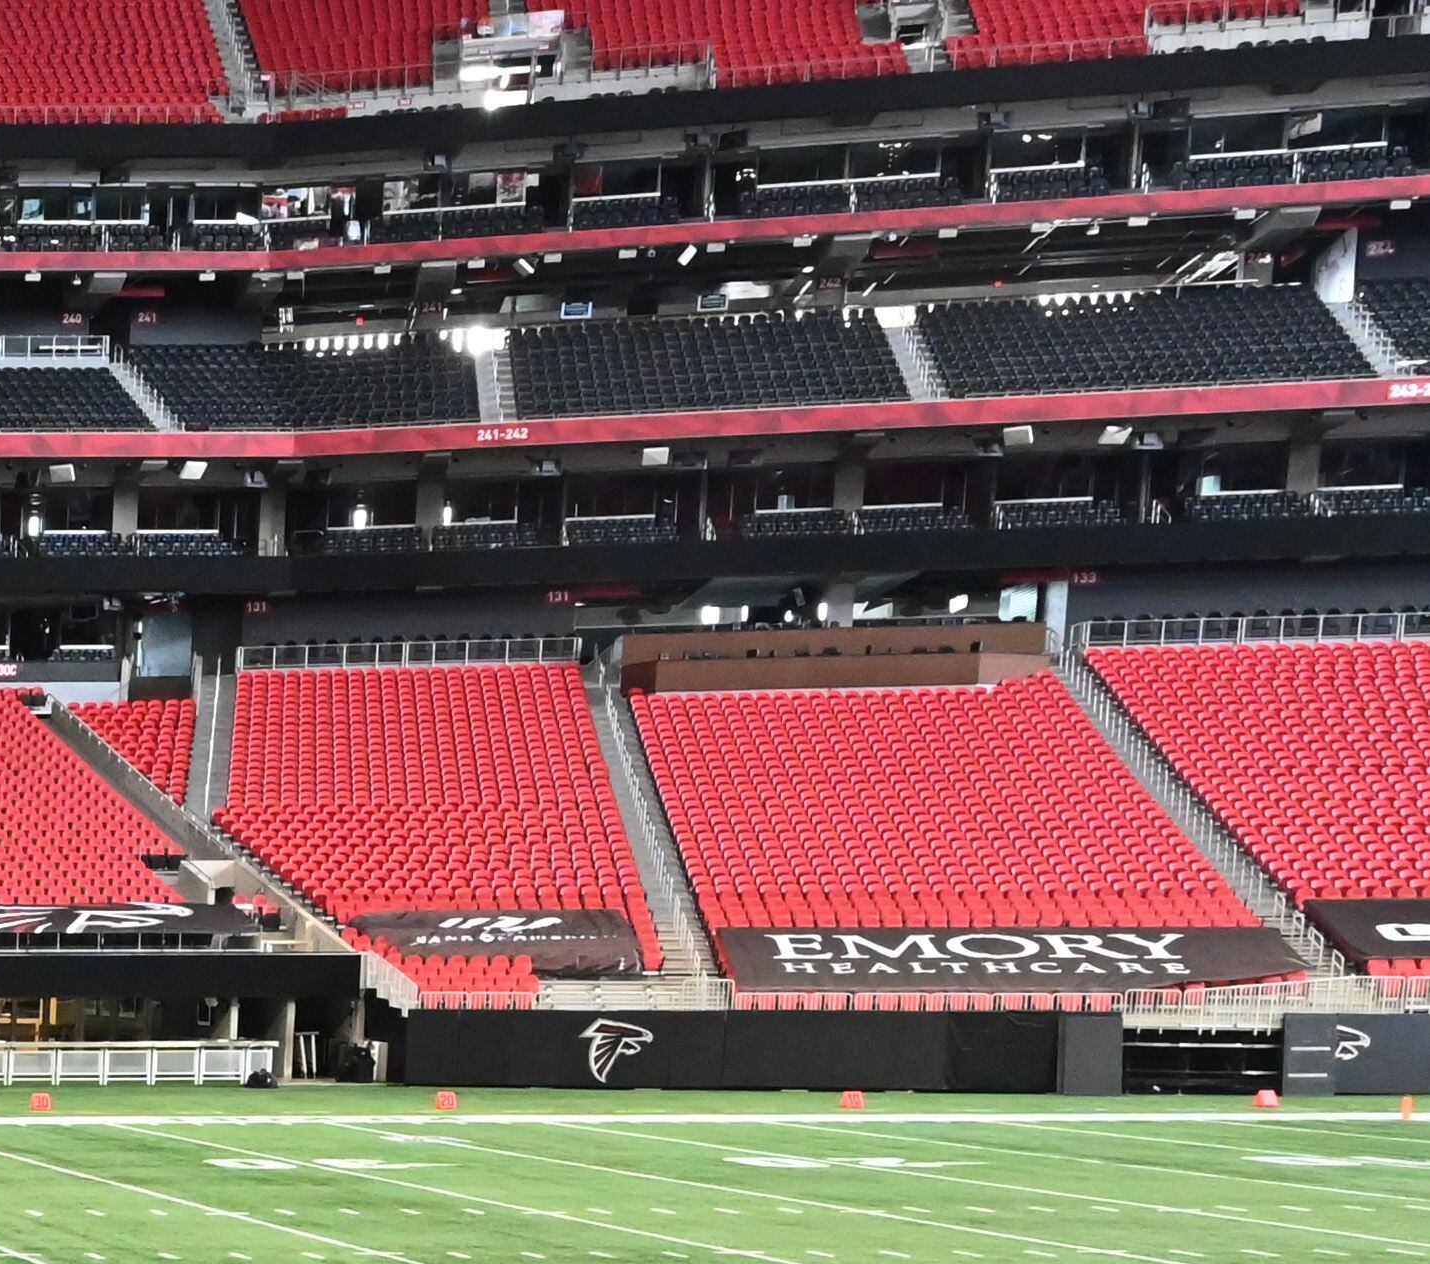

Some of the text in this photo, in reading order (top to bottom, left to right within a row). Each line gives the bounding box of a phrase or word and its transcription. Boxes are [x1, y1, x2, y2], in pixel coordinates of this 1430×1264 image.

[62, 313, 82, 324] 240
[139, 312, 156, 323] 241
[477, 428, 528, 441] 241-242
[1074, 572, 1096, 583] 133
[548, 592, 568, 602] 131
[247, 601, 266, 612] 131
[763, 933, 1185, 959] EMORY
[783, 962, 1191, 974] HEALTHCARE
[441, 1094, 454, 1106] 20
